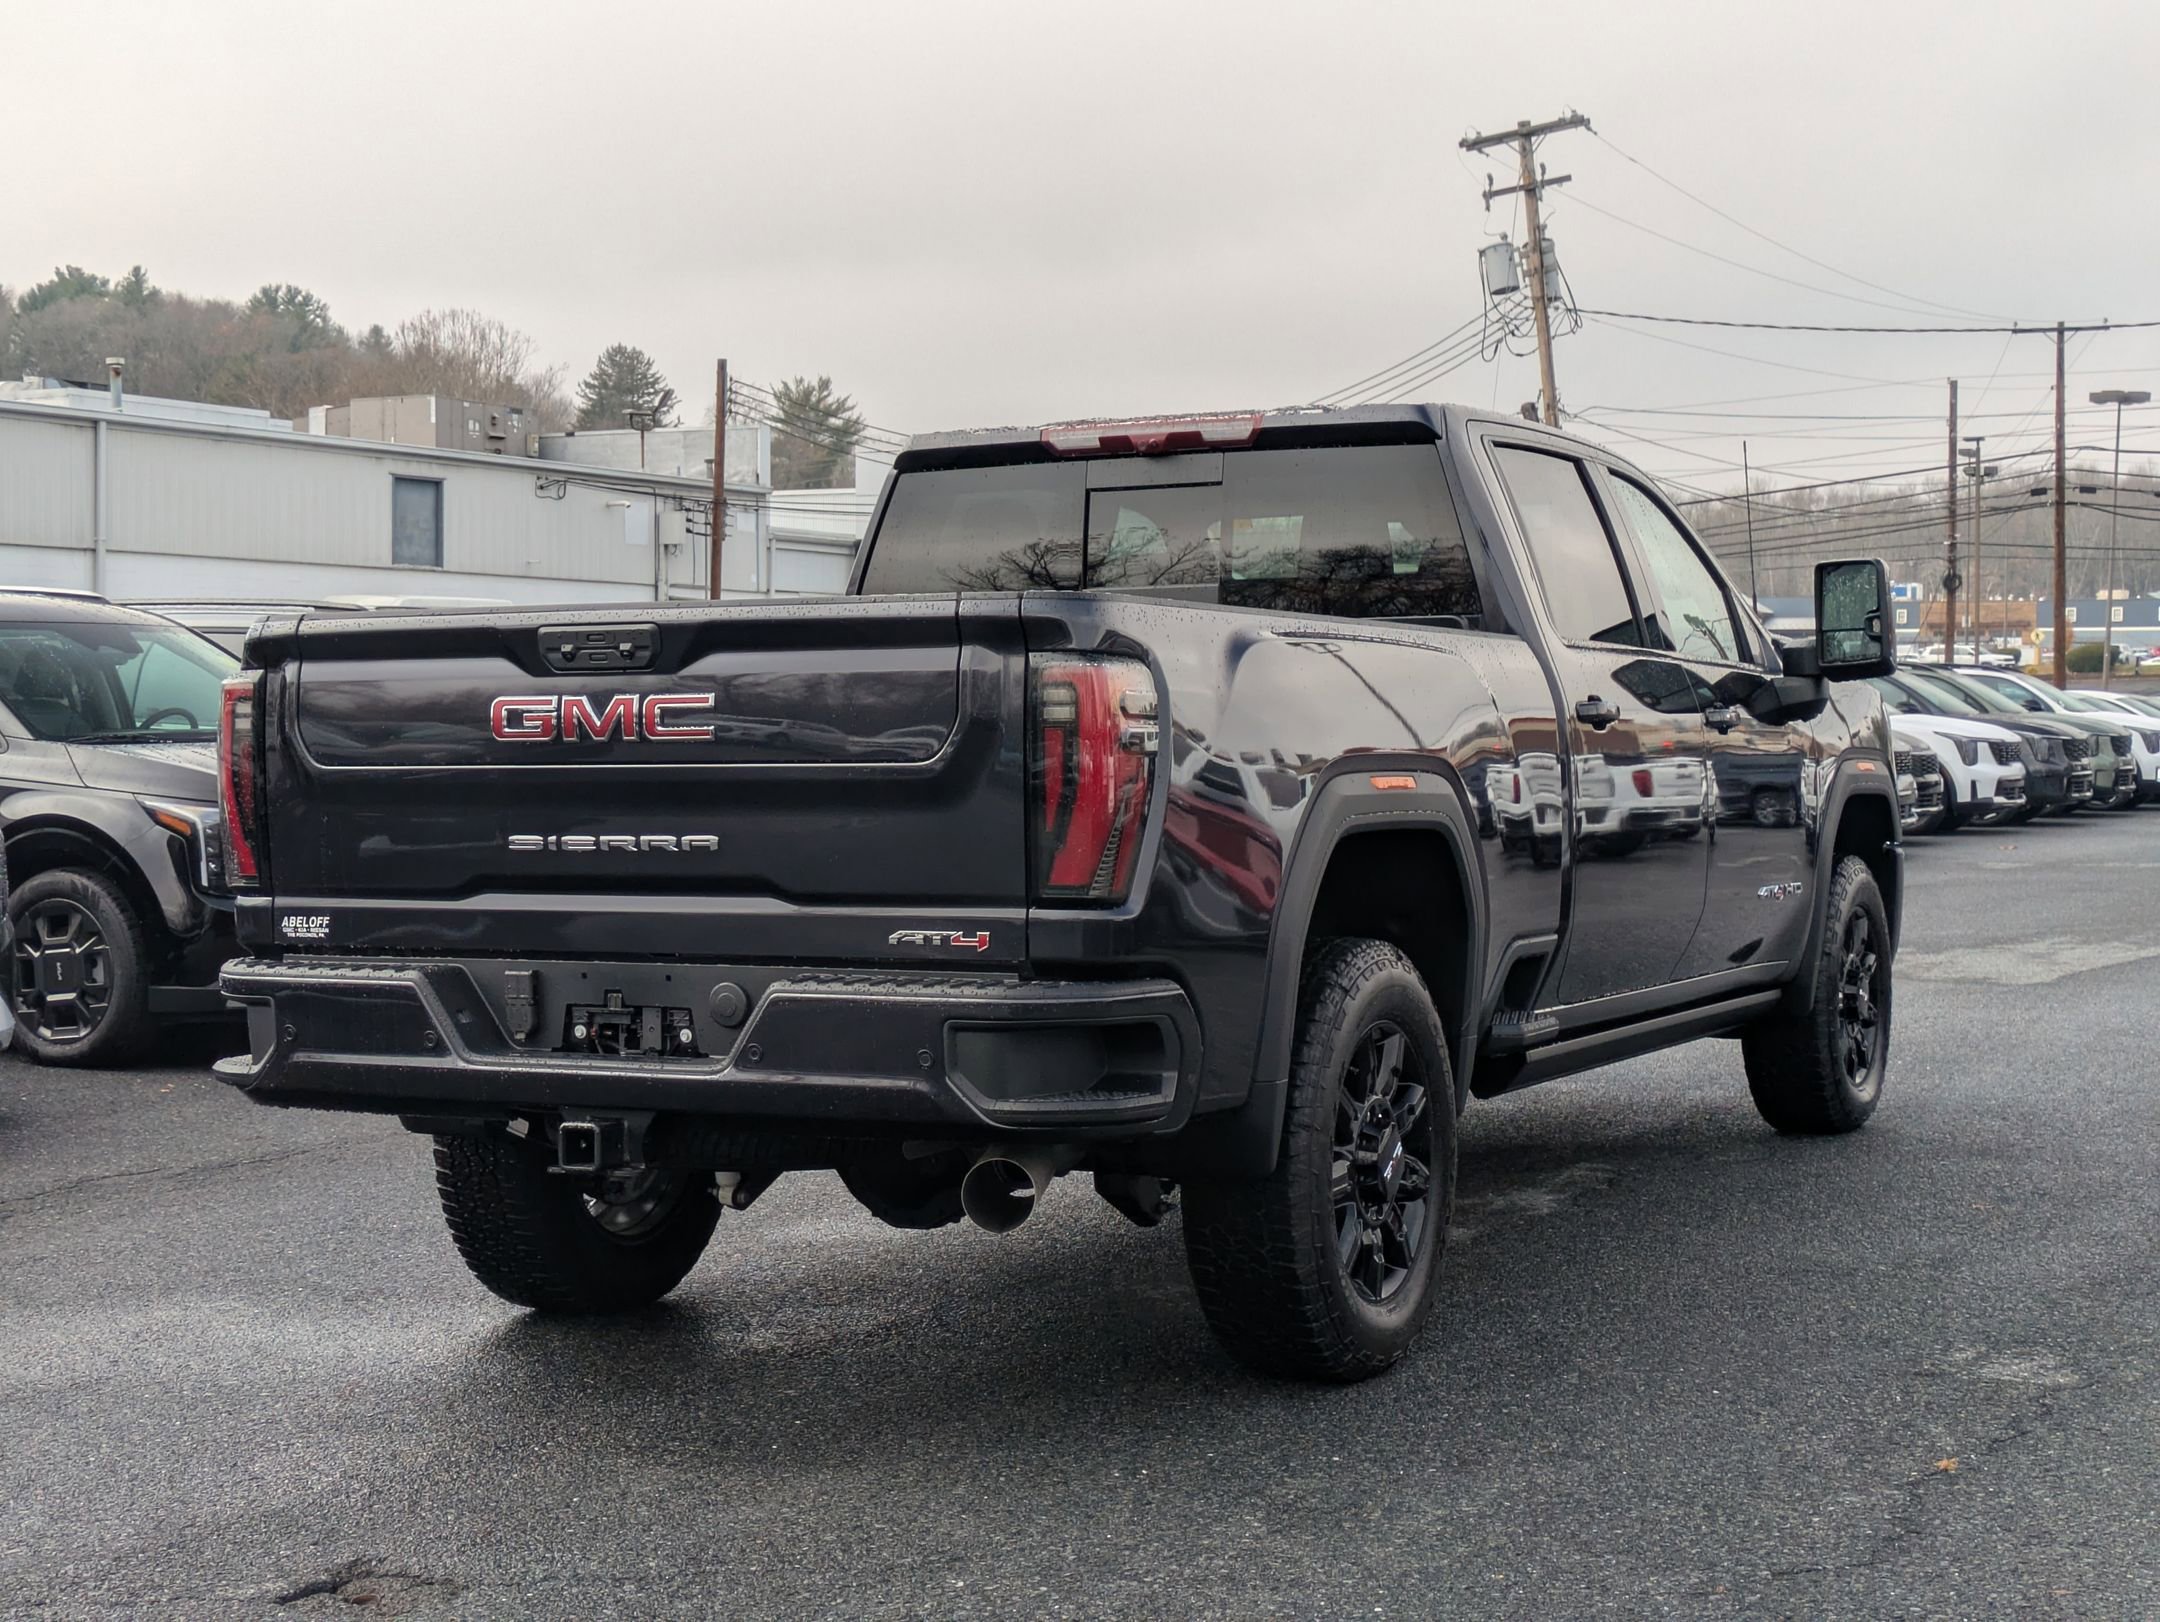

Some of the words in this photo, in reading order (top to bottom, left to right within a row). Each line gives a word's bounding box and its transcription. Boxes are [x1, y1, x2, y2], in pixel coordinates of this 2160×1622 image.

[490, 693, 716, 743] GMC
[508, 834, 719, 851] SIERRA
[281, 916, 330, 927] ABELOFF
[888, 930, 990, 952] AT4
